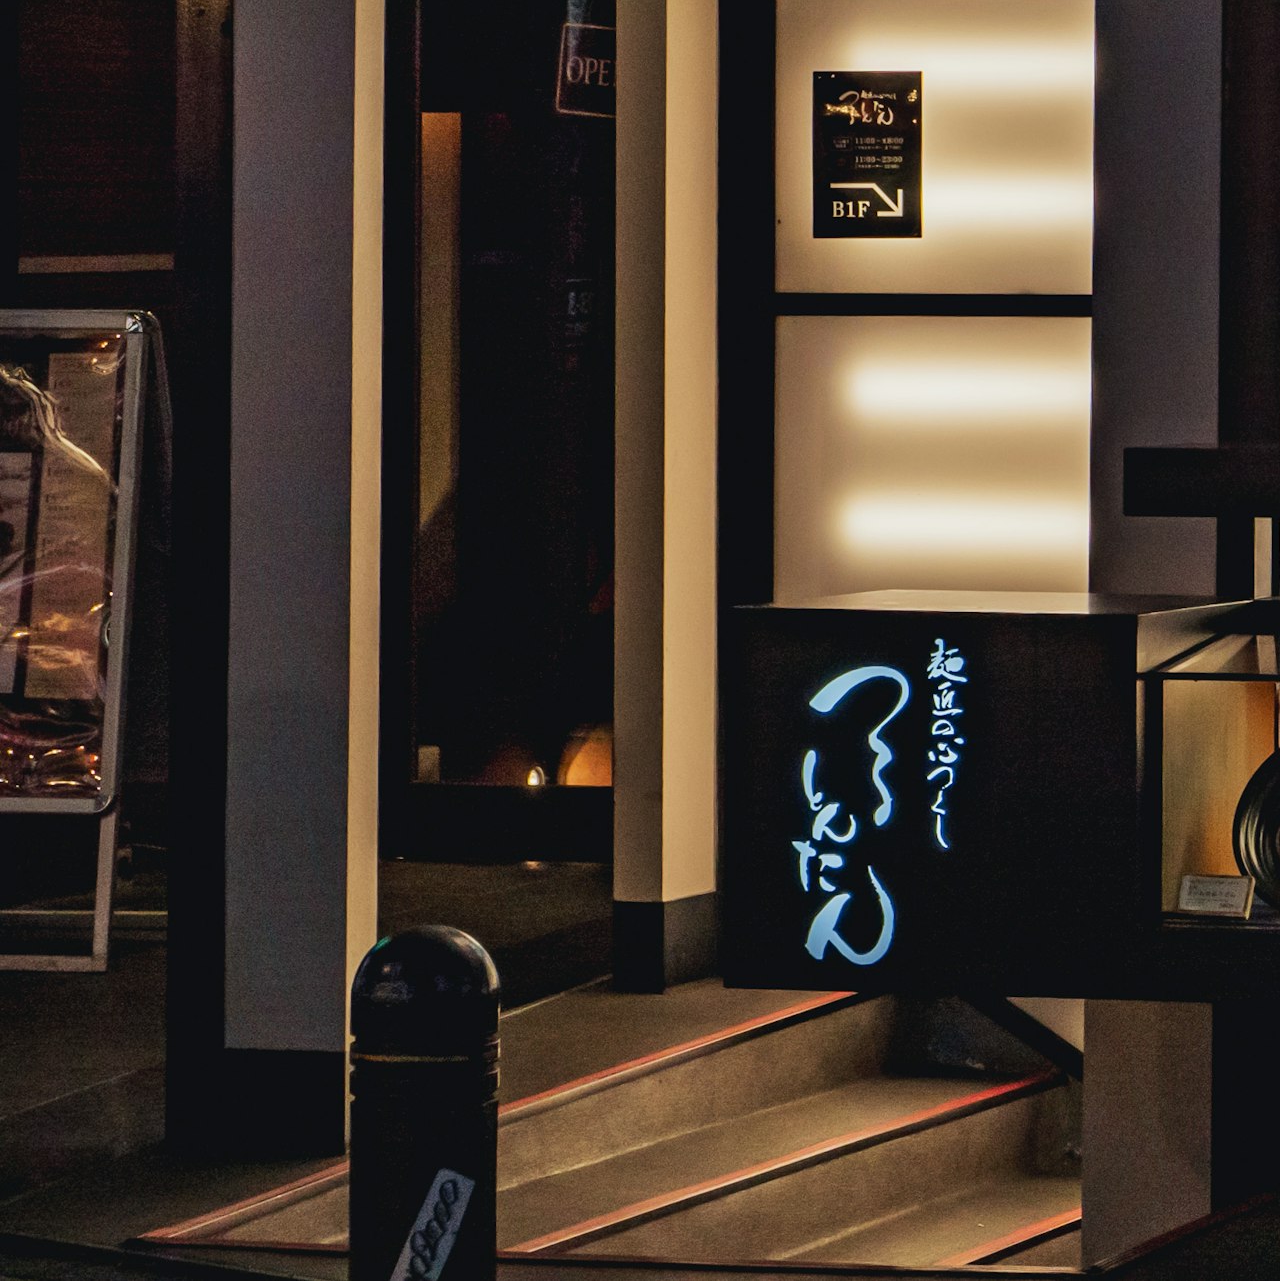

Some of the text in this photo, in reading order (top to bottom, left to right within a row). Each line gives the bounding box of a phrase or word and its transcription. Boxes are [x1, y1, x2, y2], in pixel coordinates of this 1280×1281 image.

[566, 56, 616, 86] OPE
[832, 200, 871, 218] B1F
[925, 637, 970, 849] 麺匠の心つくし
